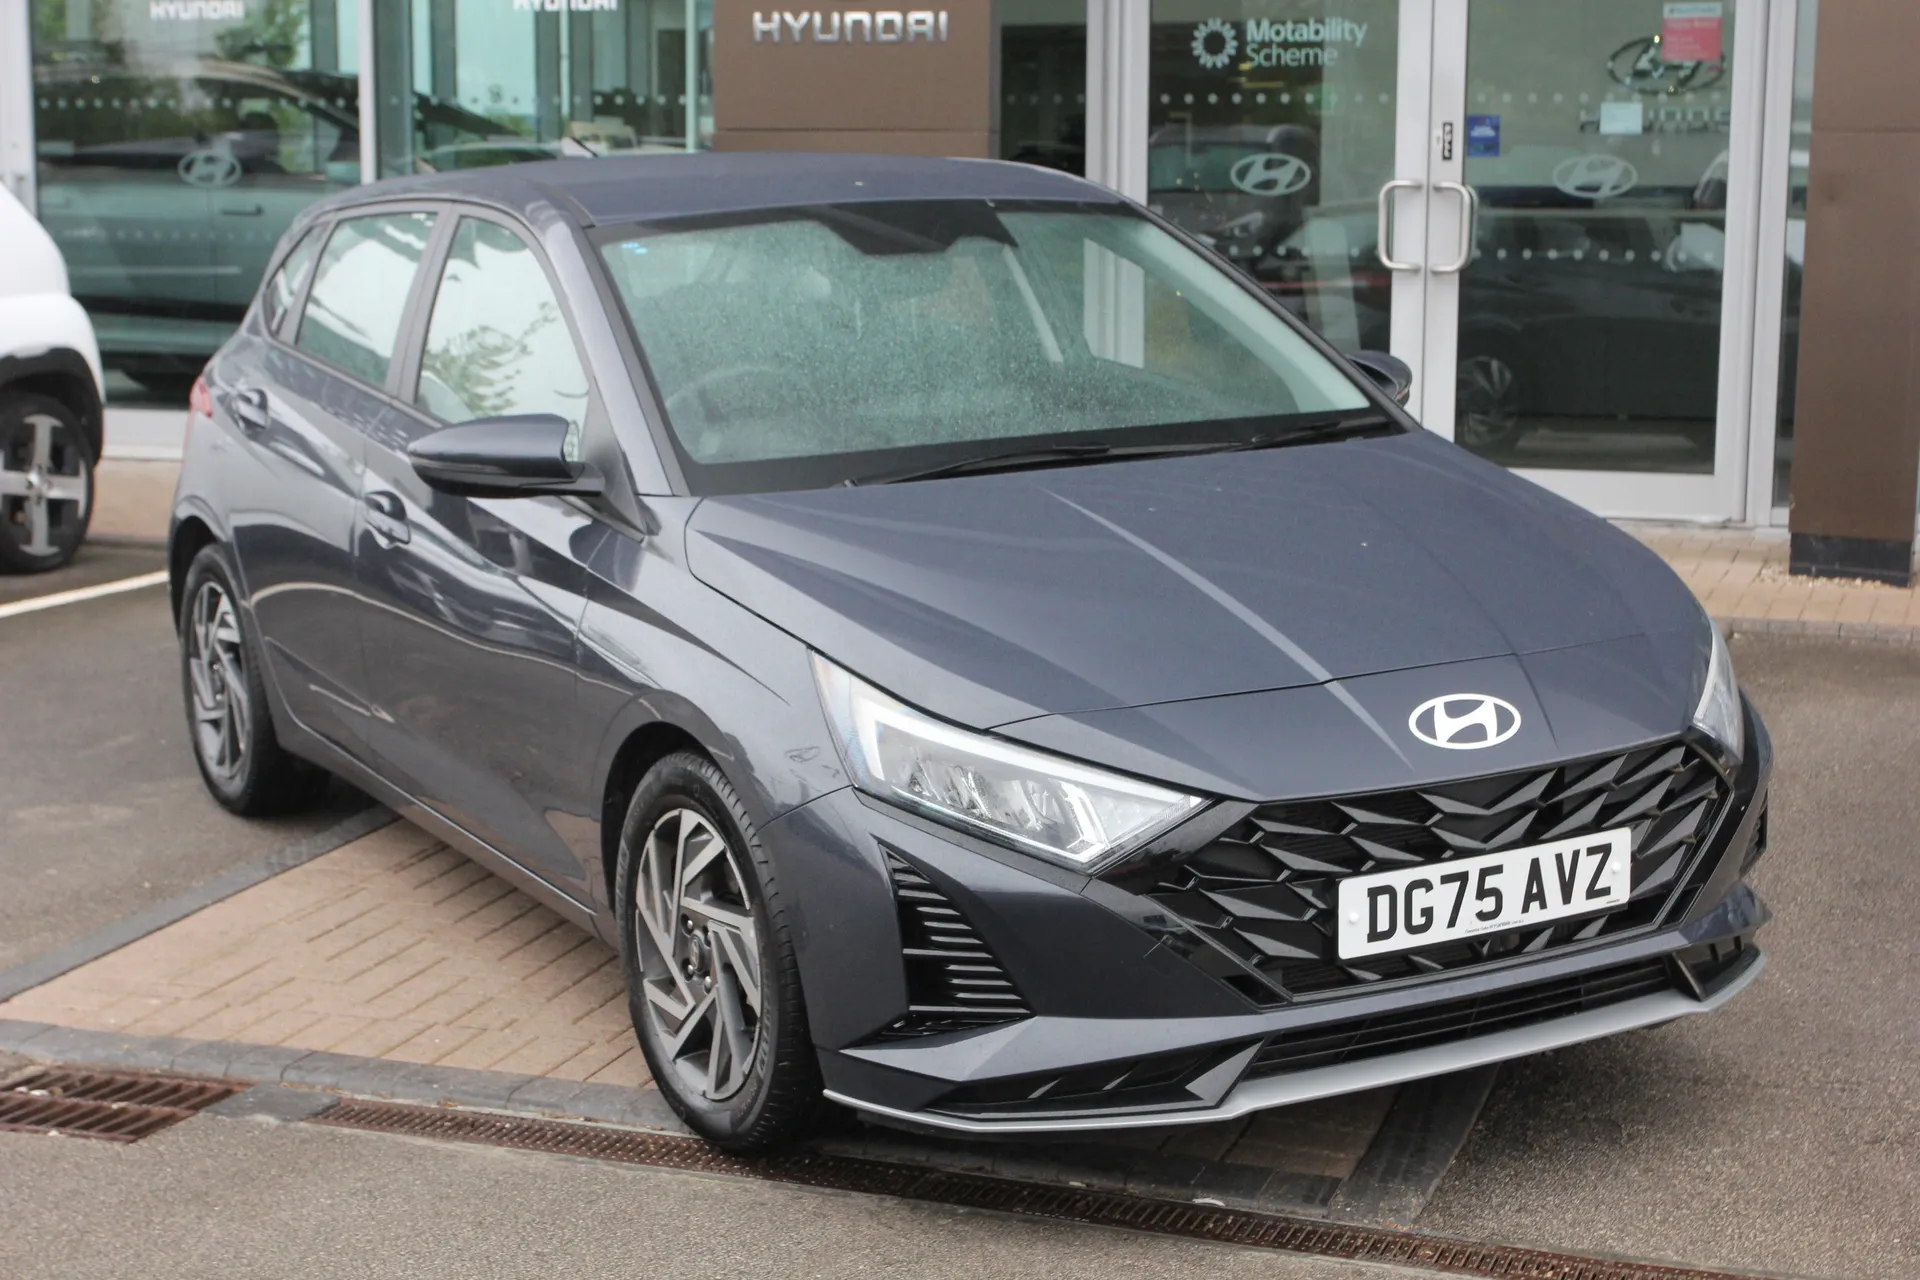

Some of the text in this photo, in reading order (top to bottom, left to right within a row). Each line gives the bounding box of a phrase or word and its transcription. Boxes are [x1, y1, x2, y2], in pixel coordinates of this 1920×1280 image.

[752, 11, 948, 43] HYUNDAI
[1246, 18, 1368, 47] Motability
[1246, 44, 1338, 67] Scheme
[1367, 842, 1612, 944] DG75 AVZ
